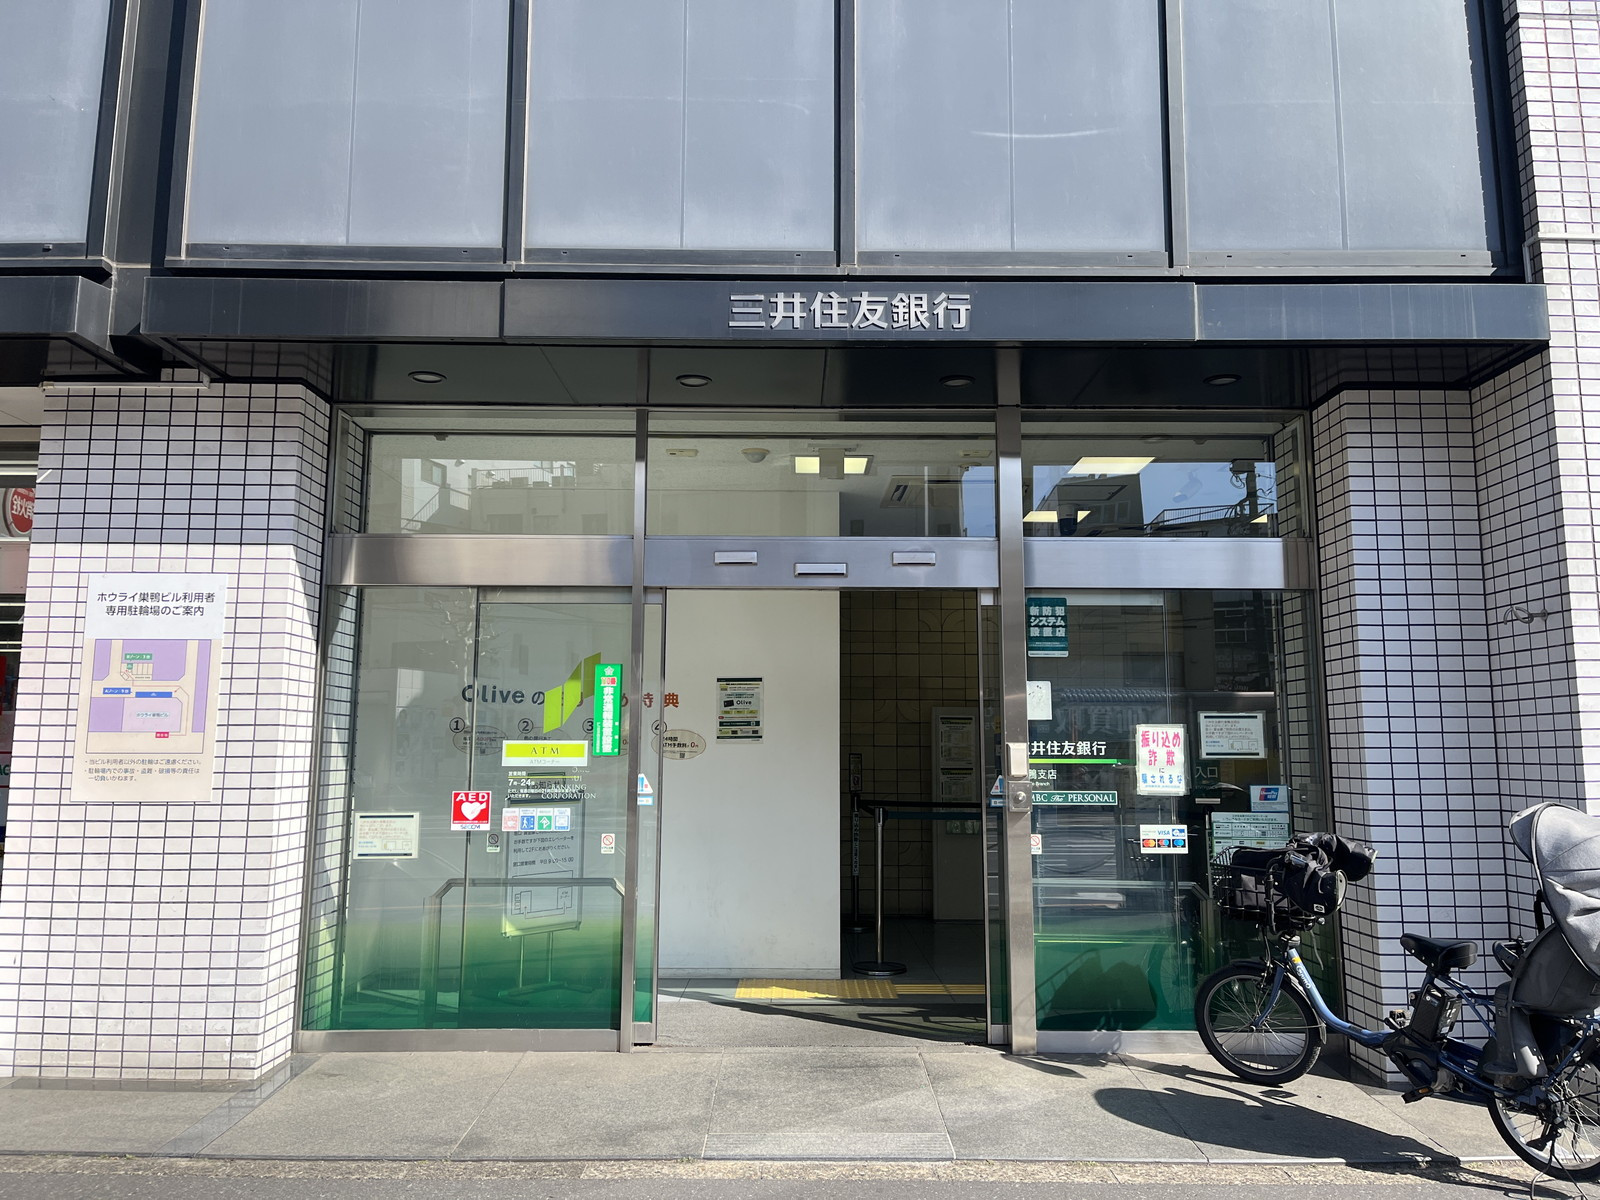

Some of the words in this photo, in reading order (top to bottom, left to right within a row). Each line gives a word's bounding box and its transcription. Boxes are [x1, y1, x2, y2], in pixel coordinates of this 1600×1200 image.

[728, 291, 972, 330] 三井住友銀行
[97, 592, 216, 603] ホウライ巣鴨ビル利用者
[105, 605, 205, 617] 専用駐輪場のご案内
[1030, 606, 1065, 616] 新防犯
[1030, 617, 1065, 626] システム
[1030, 627, 1066, 637] 設置店
[1141, 730, 1181, 748] 振り込め
[530, 747, 559, 755] ATM
[1148, 749, 1175, 766] 詐欺
[1195, 766, 1218, 778] 入口
[456, 793, 488, 801] AED
[1068, 794, 1115, 802] PERSONAL
